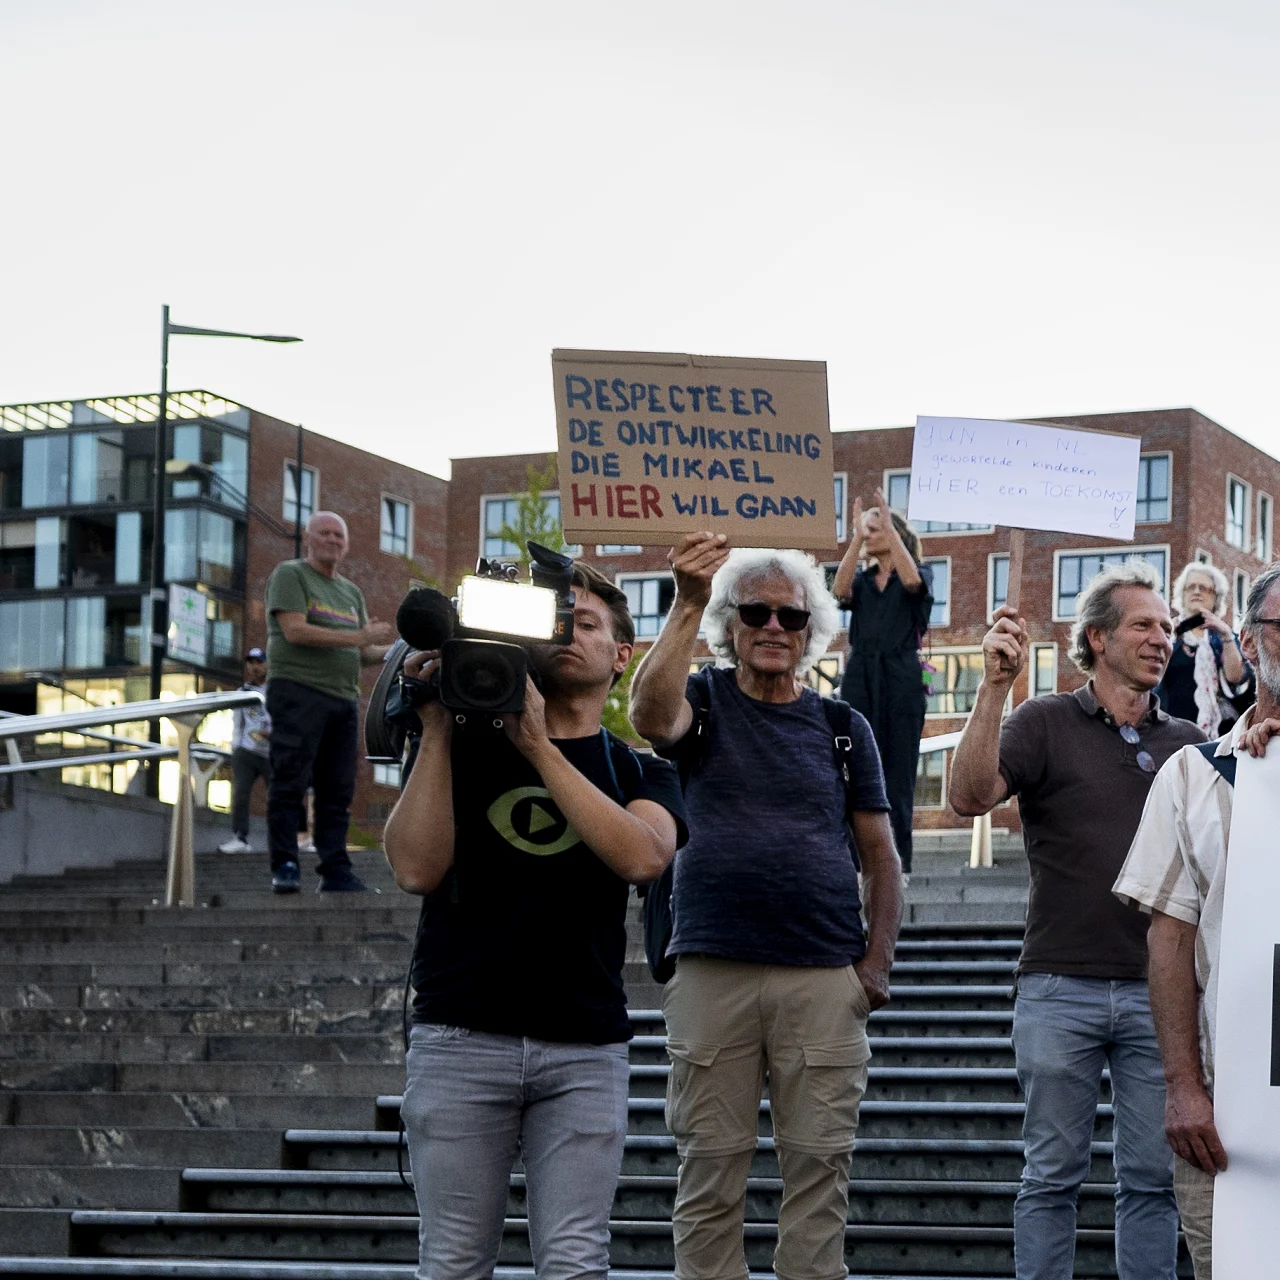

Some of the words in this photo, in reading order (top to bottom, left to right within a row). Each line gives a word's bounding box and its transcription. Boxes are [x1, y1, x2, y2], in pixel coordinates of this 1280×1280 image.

[564, 372, 777, 417] RESPECTEER
[568, 417, 604, 448] DE
[616, 419, 822, 461] ONTWIKKELING
[571, 450, 621, 478] DIE
[643, 452, 775, 484] MIKAEL
[571, 482, 664, 519] HIER
[671, 491, 730, 517] WIL
[735, 492, 818, 520] GAAN
[998, 485, 1028, 495] een
